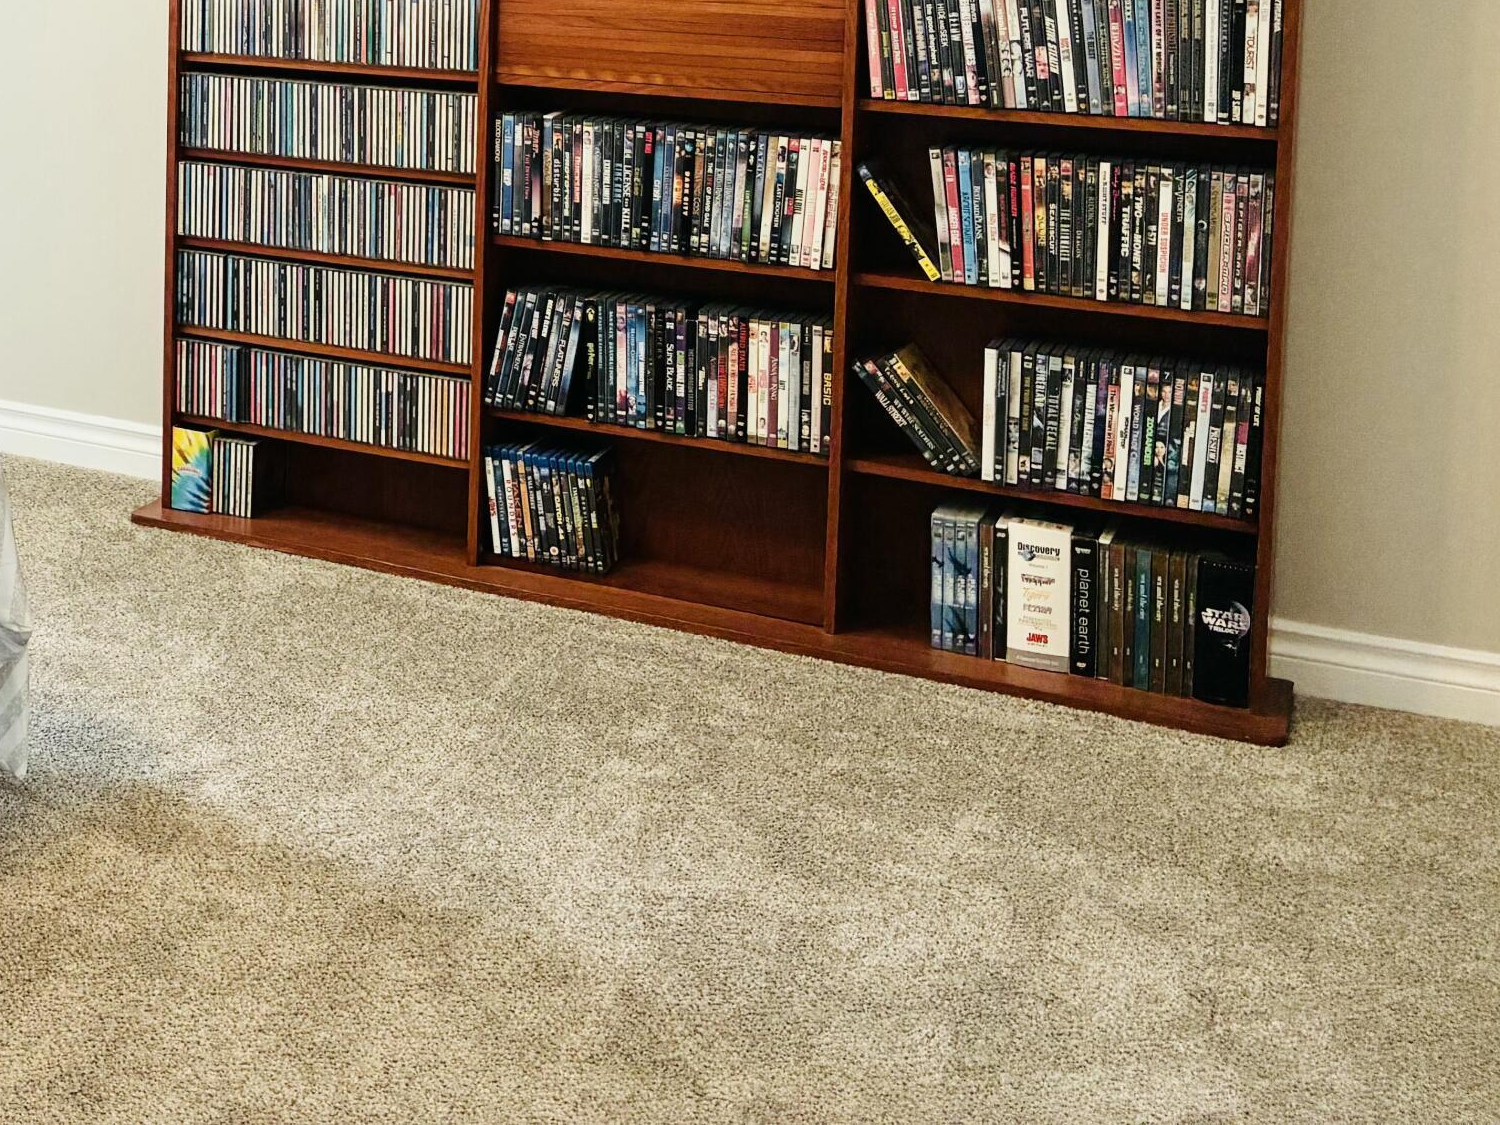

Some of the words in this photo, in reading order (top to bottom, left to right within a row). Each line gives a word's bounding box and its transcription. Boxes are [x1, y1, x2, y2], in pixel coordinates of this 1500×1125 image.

[926, 16, 935, 33] good
[936, 3, 945, 19] HIDE
[928, 34, 938, 65] shepherd
[939, 30, 948, 47] SEEK
[1019, 7, 1031, 50] FUTURE
[1025, 52, 1034, 78] WAR
[1246, 35, 1255, 70] TOURIST
[1047, 42, 1059, 74] STEALTH
[553, 158, 561, 203] disturbia
[614, 163, 622, 183] KING
[623, 164, 632, 197] LICENSE
[622, 207, 630, 230] KILL
[975, 216, 983, 239] PLANS
[1120, 205, 1130, 257] TRAFFIC
[1132, 233, 1142, 270] MONEY
[1159, 238, 1167, 273] SUSPICION
[1221, 212, 1231, 295] SPIDER-MAN
[1234, 277, 1241, 289] 3
[513, 333, 527, 371] ENTRAPMENT
[551, 339, 567, 387] FLATLINERS
[666, 343, 674, 365] SLING
[666, 367, 674, 391] BLADE
[823, 373, 831, 405] BASIC
[1173, 379, 1185, 405] RONIN
[875, 390, 889, 408] WALL
[886, 405, 907, 427] STREET
[1047, 395, 1058, 418] TOTAL
[1200, 387, 1209, 413] PORKY'S
[1132, 404, 1141, 429] WORLD
[1045, 421, 1058, 451] RECALL
[1143, 417, 1154, 466] ZOOLANDER
[506, 480, 516, 536] ROUNDERS
[513, 480, 522, 528] TAKEN
[554, 496, 562, 524] CATCH
[1018, 541, 1060, 556] Discovery
[1077, 568, 1091, 613] planet
[1026, 633, 1048, 644] JAWS
[1078, 617, 1090, 654] earth
